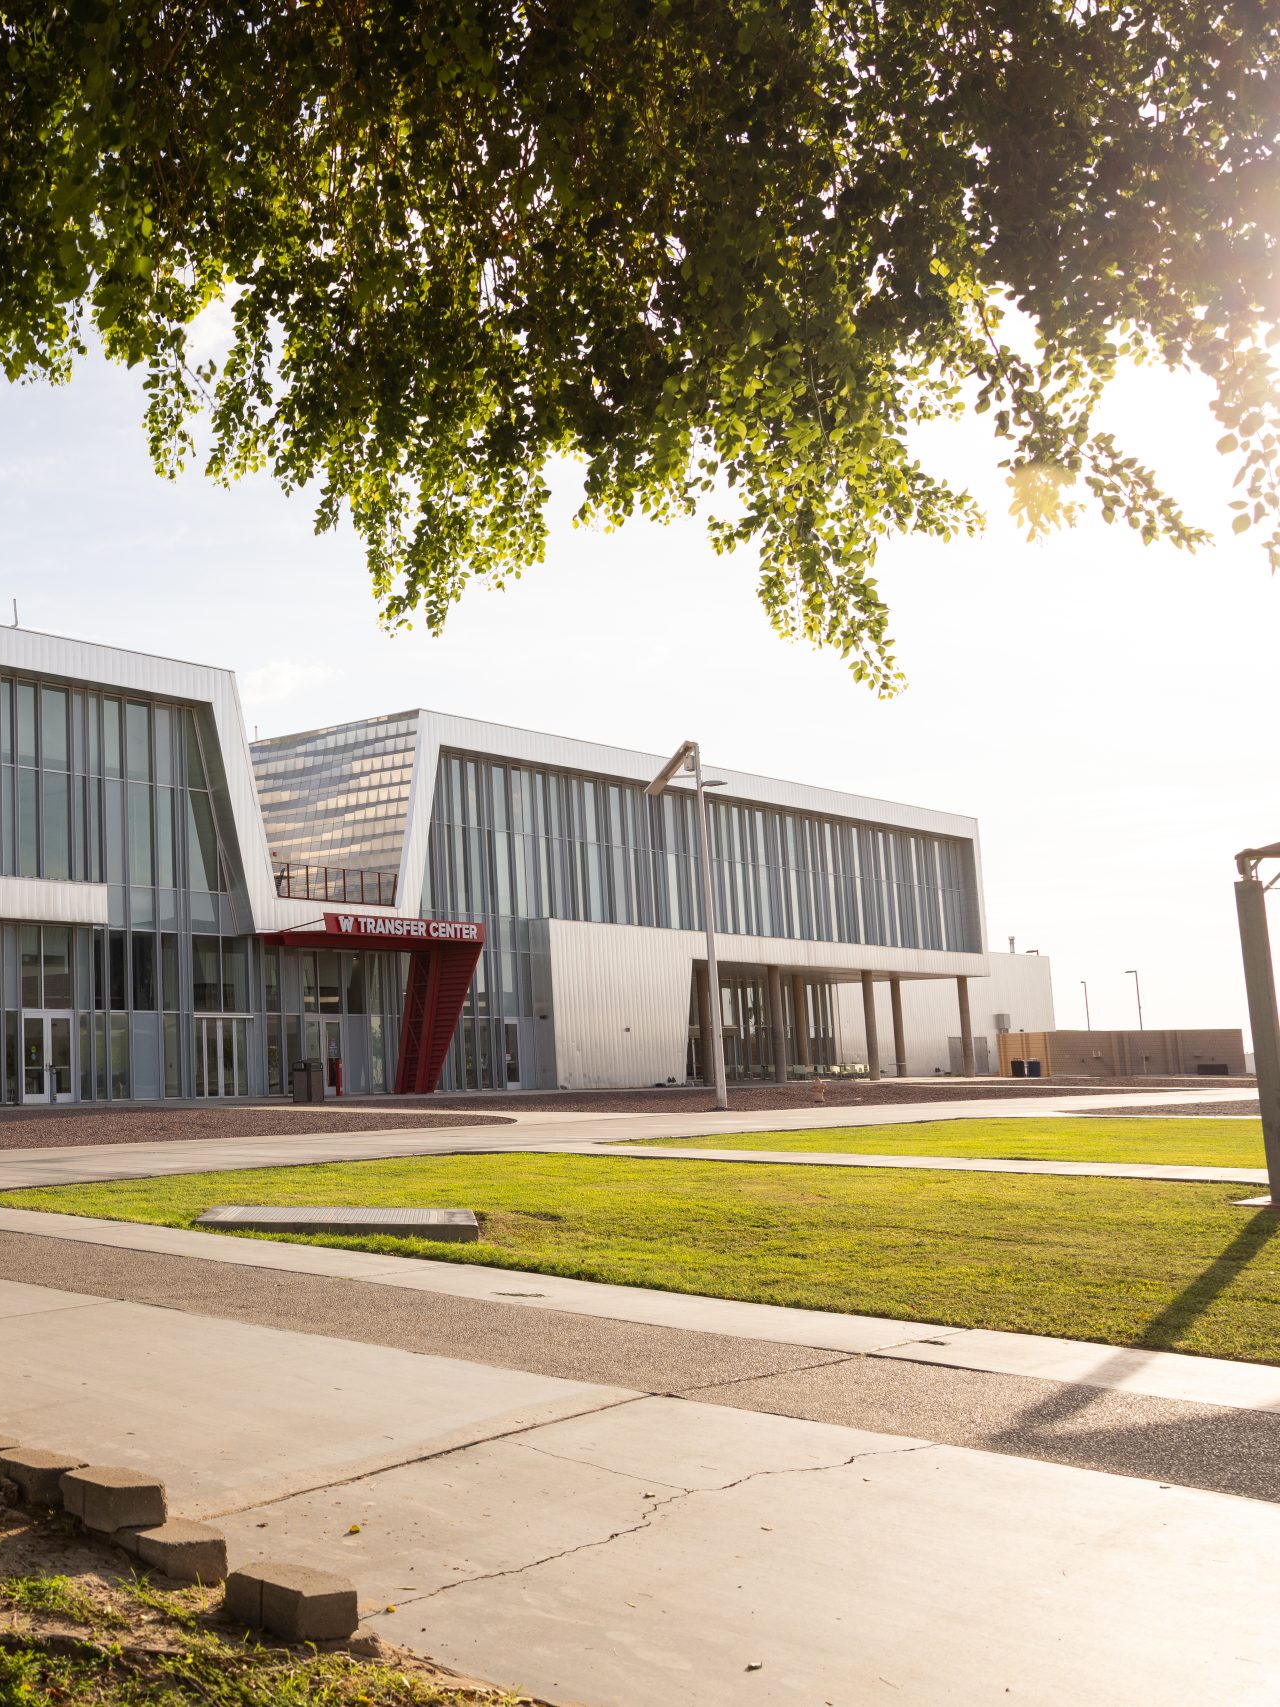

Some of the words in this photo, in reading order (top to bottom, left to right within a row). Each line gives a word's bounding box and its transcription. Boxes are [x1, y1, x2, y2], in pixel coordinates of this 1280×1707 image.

[338, 916, 354, 933] W
[358, 916, 427, 937] TRANSFER
[429, 922, 477, 940] CENTER
